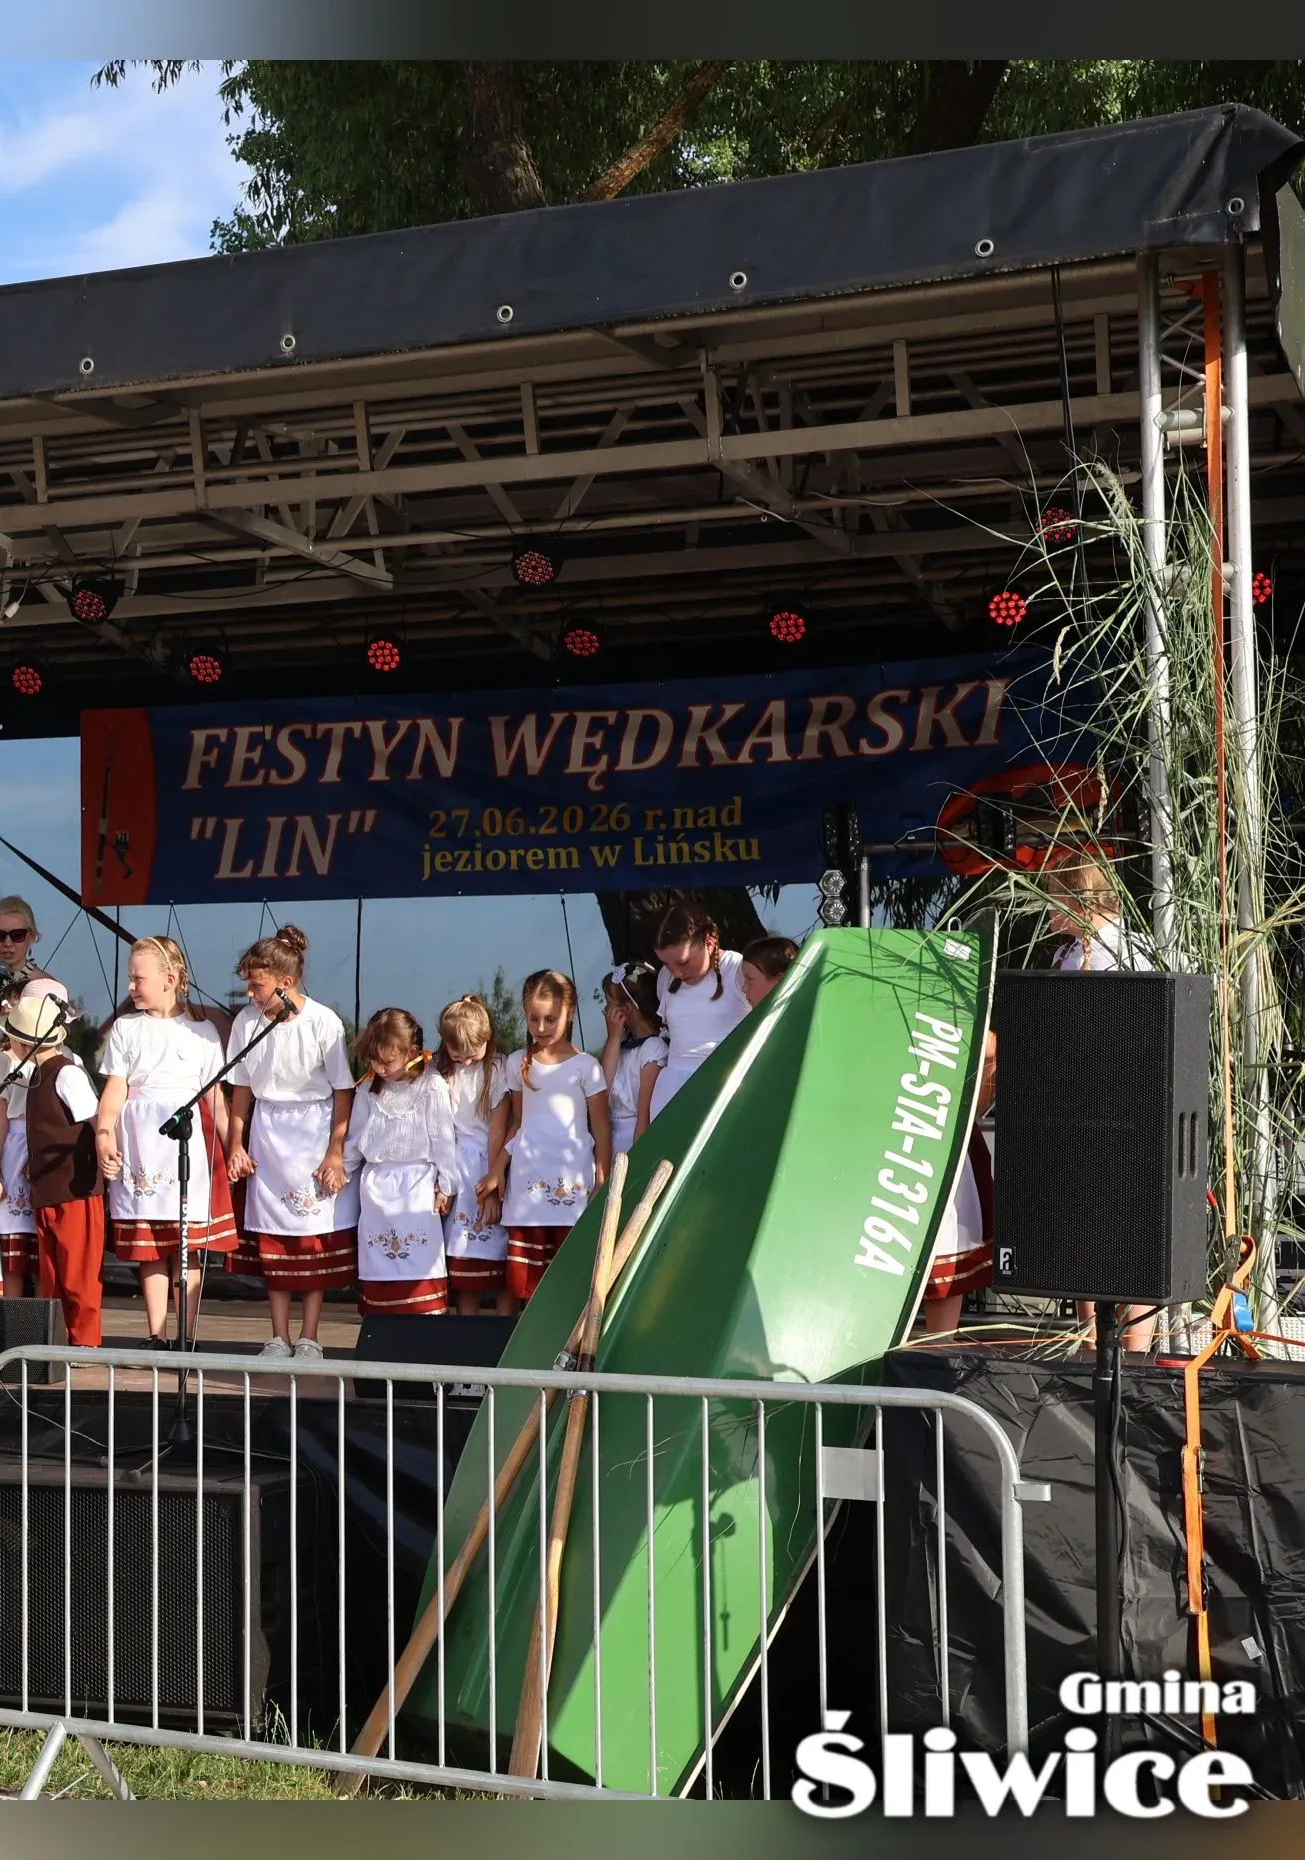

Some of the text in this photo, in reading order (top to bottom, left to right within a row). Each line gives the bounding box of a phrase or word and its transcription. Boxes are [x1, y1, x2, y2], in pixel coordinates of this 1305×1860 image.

[181, 678, 1010, 792] FESTYN WĘDKARSKI
[190, 809, 378, 879] "LIN"
[428, 802, 631, 838] 27.06.2026
[421, 832, 762, 881] jeziorem w Lińsku
[853, 1012, 963, 1277] PM-STA-1316A
